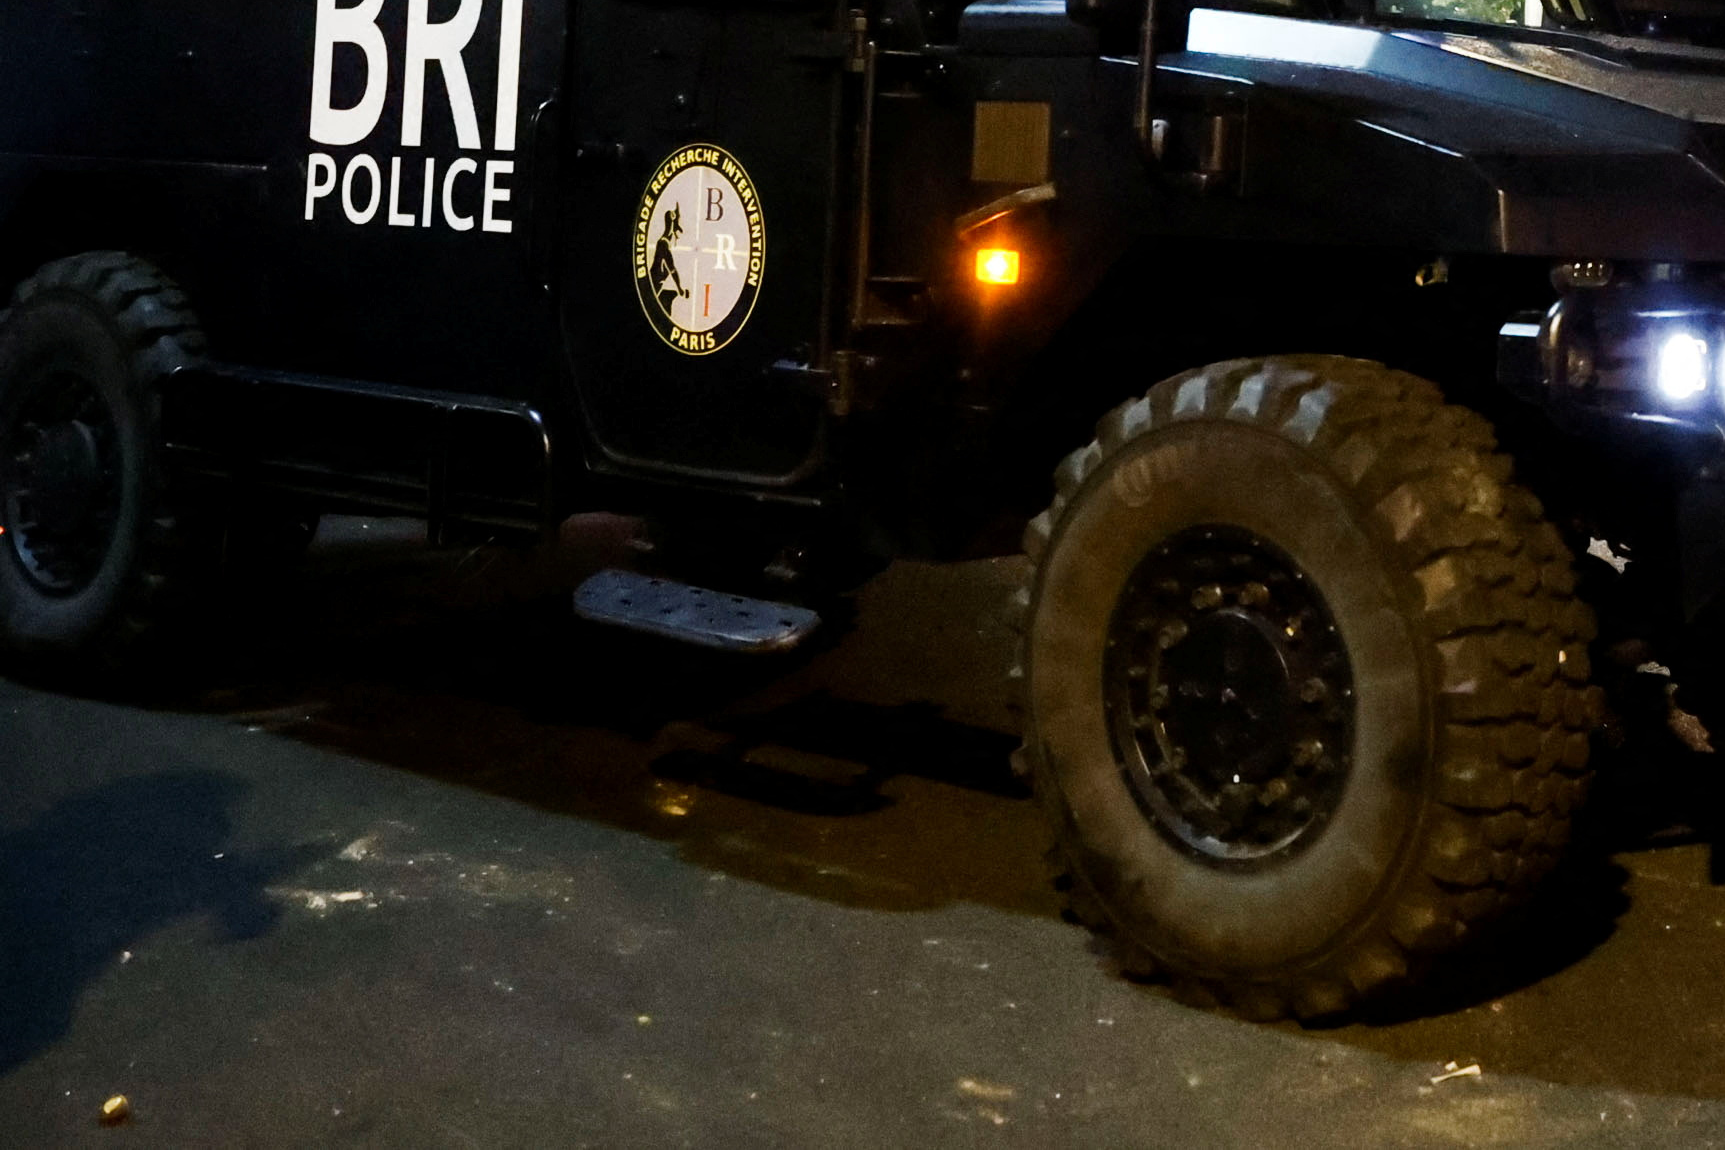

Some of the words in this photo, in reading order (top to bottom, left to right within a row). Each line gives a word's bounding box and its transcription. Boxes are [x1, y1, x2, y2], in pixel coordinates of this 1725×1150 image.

[304, 152, 515, 233] POLICE
[636, 195, 654, 279] BRIGADE
[651, 149, 720, 194] RECHERCHE
[722, 158, 762, 287] INTERVENTION
[670, 326, 715, 350] PARIS
